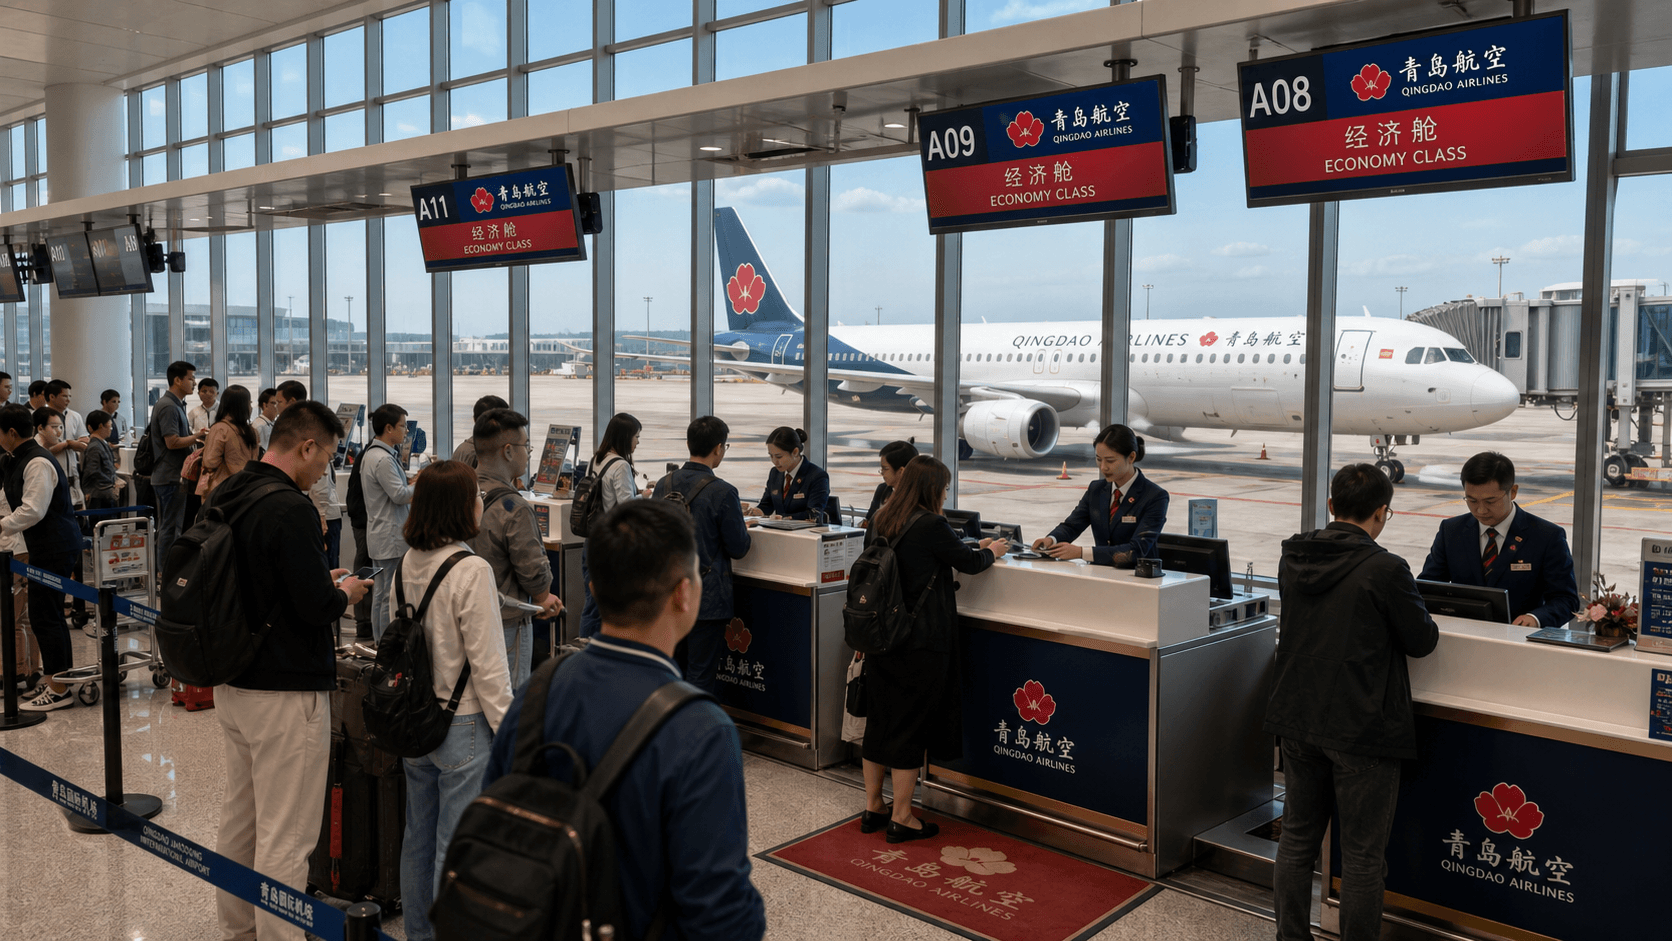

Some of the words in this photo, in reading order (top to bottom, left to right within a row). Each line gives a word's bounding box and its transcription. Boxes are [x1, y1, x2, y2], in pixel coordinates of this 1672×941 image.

[1399, 44, 1507, 83] 青岛航空
[1249, 75, 1312, 118] A08
[1401, 81, 1453, 97] QINGDAO
[1457, 73, 1508, 88] AIRLINES
[1050, 100, 1130, 132] 青岛航空
[927, 125, 976, 161] A09
[1053, 131, 1092, 144] QINGDAO
[1094, 125, 1133, 138] AIRLINES
[1344, 115, 1437, 150] 经济舱
[1325, 152, 1407, 173] ECONOMY
[1412, 145, 1467, 164] CLASS
[1004, 160, 1073, 188] 经济舱
[497, 180, 549, 202] 青岛航空
[990, 189, 1051, 207] ECONOMY
[1056, 185, 1096, 200] CLASS
[419, 194, 449, 221] A11
[471, 221, 517, 241] 经济舱
[464, 243, 503, 255] ECONOMY
[506, 239, 532, 251] CLASS
[1012, 335, 1092, 348] QINGDAO
[1225, 331, 1306, 348] 青岛航空
[993, 719, 1075, 760] 青岛航空
[993, 744, 1034, 763] QINGDAO
[1035, 756, 1076, 774] AIRLINES
[1442, 828, 1574, 886] 青岛航空
[850, 858, 928, 888] QINGDAO
[928, 886, 1016, 921] AIRLINES
[872, 849, 1035, 911] 青岛航空
[1441, 859, 1505, 884] QINGDAO
[1509, 877, 1575, 904] AIRLINES
